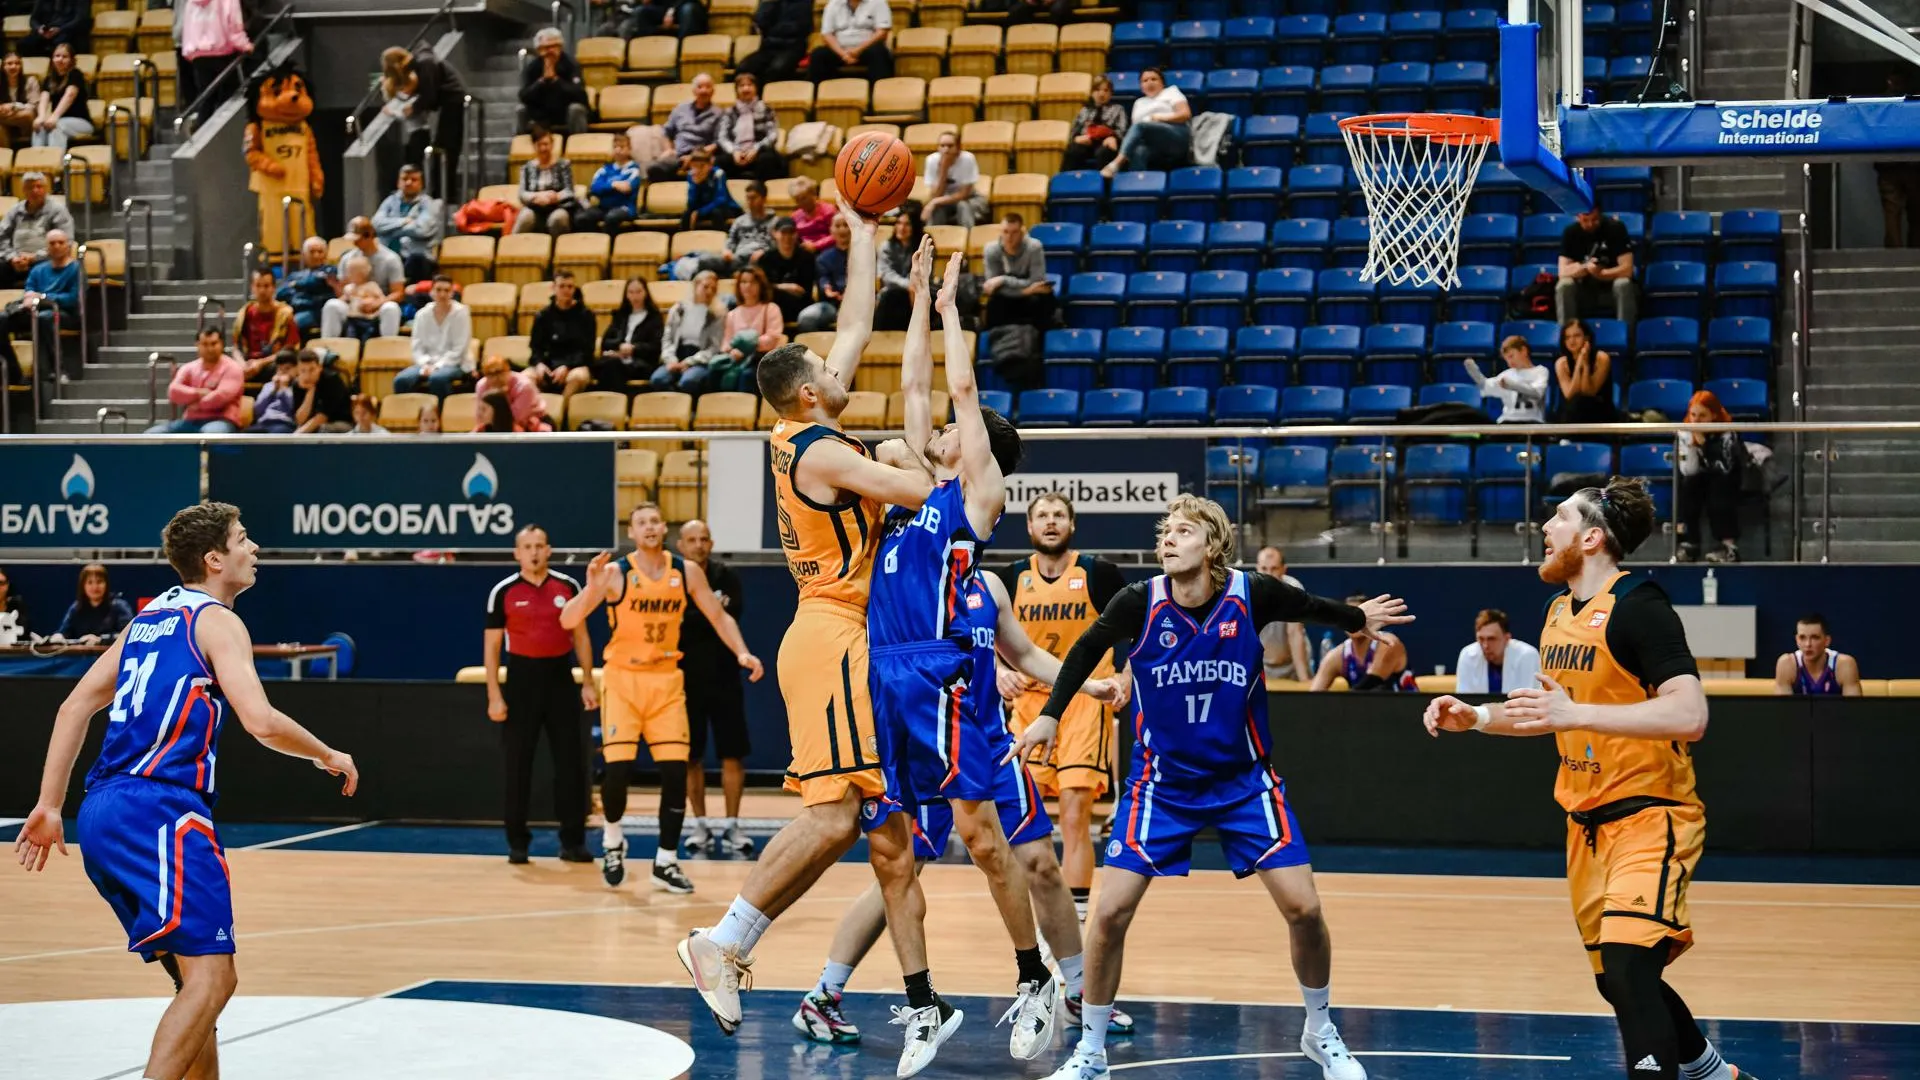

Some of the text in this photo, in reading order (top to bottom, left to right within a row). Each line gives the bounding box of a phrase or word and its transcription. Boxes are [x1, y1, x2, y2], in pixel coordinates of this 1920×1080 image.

[1720, 109, 1823, 129] Schelde
[1718, 131, 1820, 144] International
[293, 502, 515, 535] МОСОБЛГАЗ
[629, 599, 682, 613] ХИМКИ
[1018, 602, 1087, 622] ХИМКИ
[1541, 643, 1597, 672] ХИМКИ
[109, 651, 159, 723] 24
[1151, 660, 1247, 688] ТАМБОВ
[1185, 692, 1213, 724] 17
